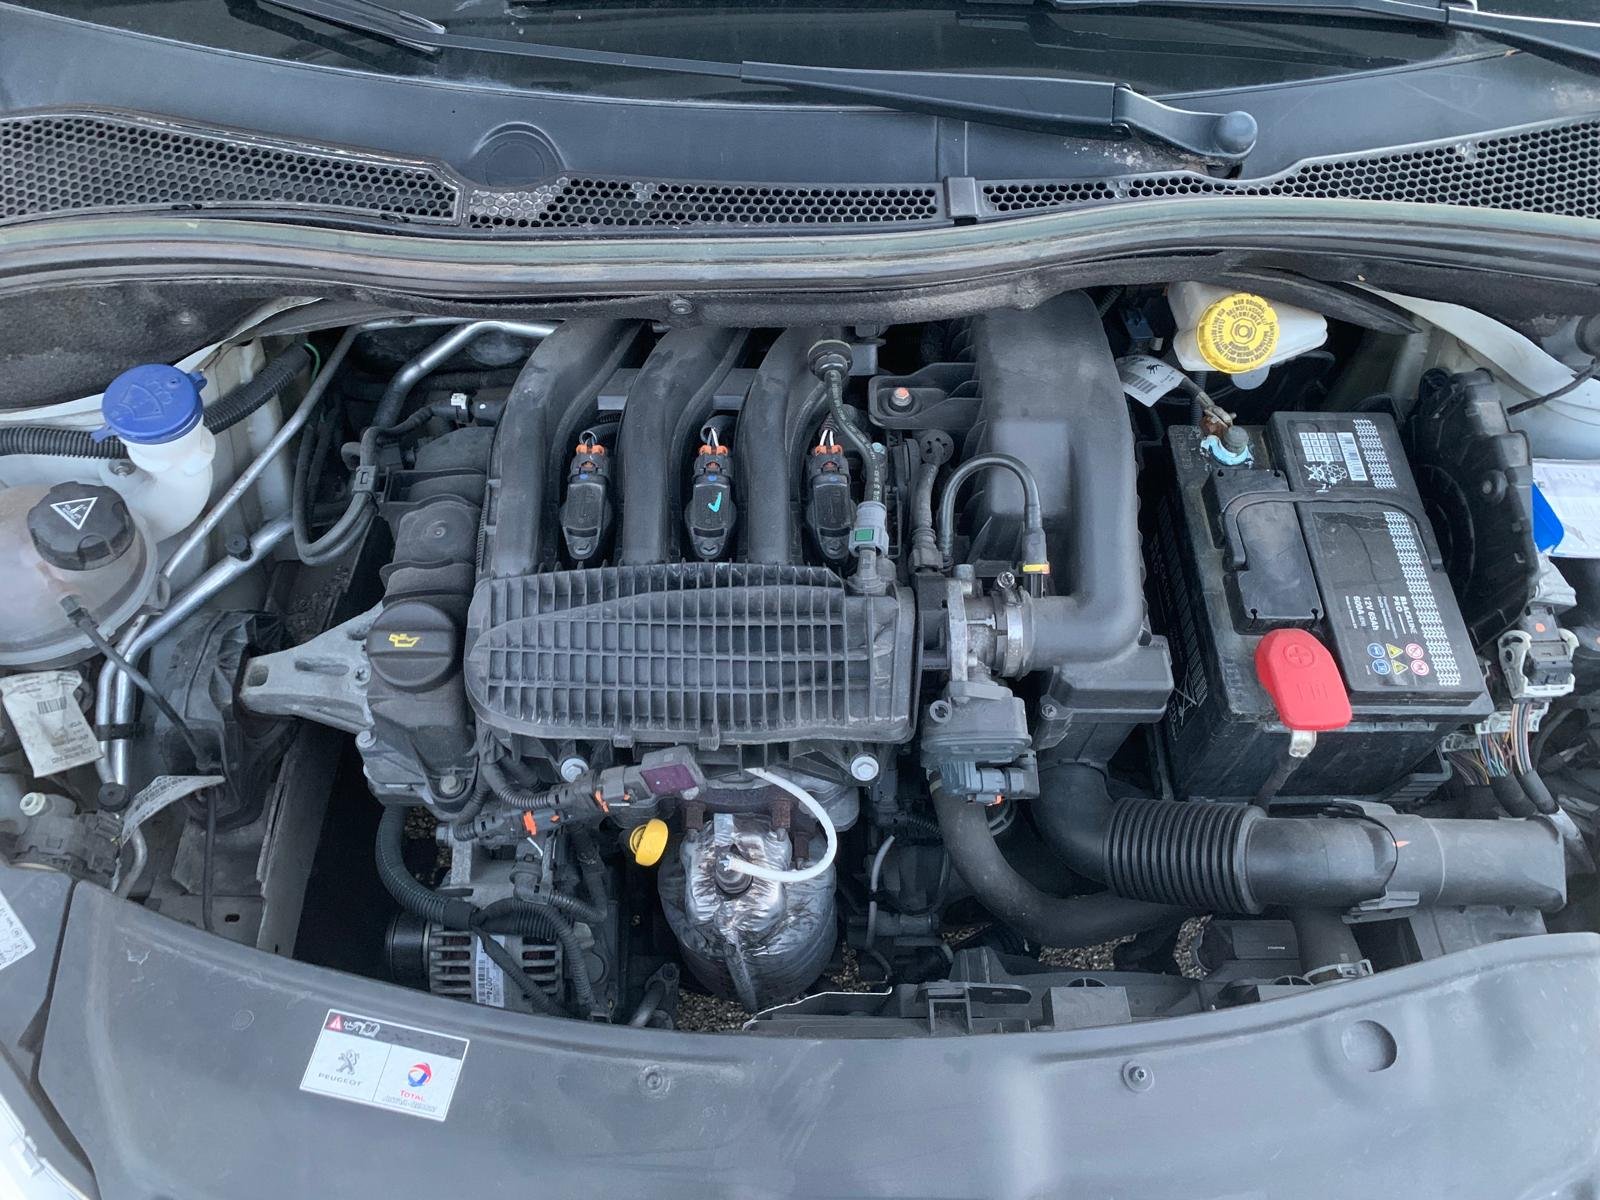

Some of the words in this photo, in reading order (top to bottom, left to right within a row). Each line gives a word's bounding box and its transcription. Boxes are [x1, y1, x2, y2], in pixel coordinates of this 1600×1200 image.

[1364, 597, 1374, 611] 12V
[1393, 596, 1403, 613] PRO
[1400, 596, 1417, 634] BLACKLINE
[318, 1072, 363, 1087] PEUGEOT
[400, 1089, 425, 1102] TOTAL
